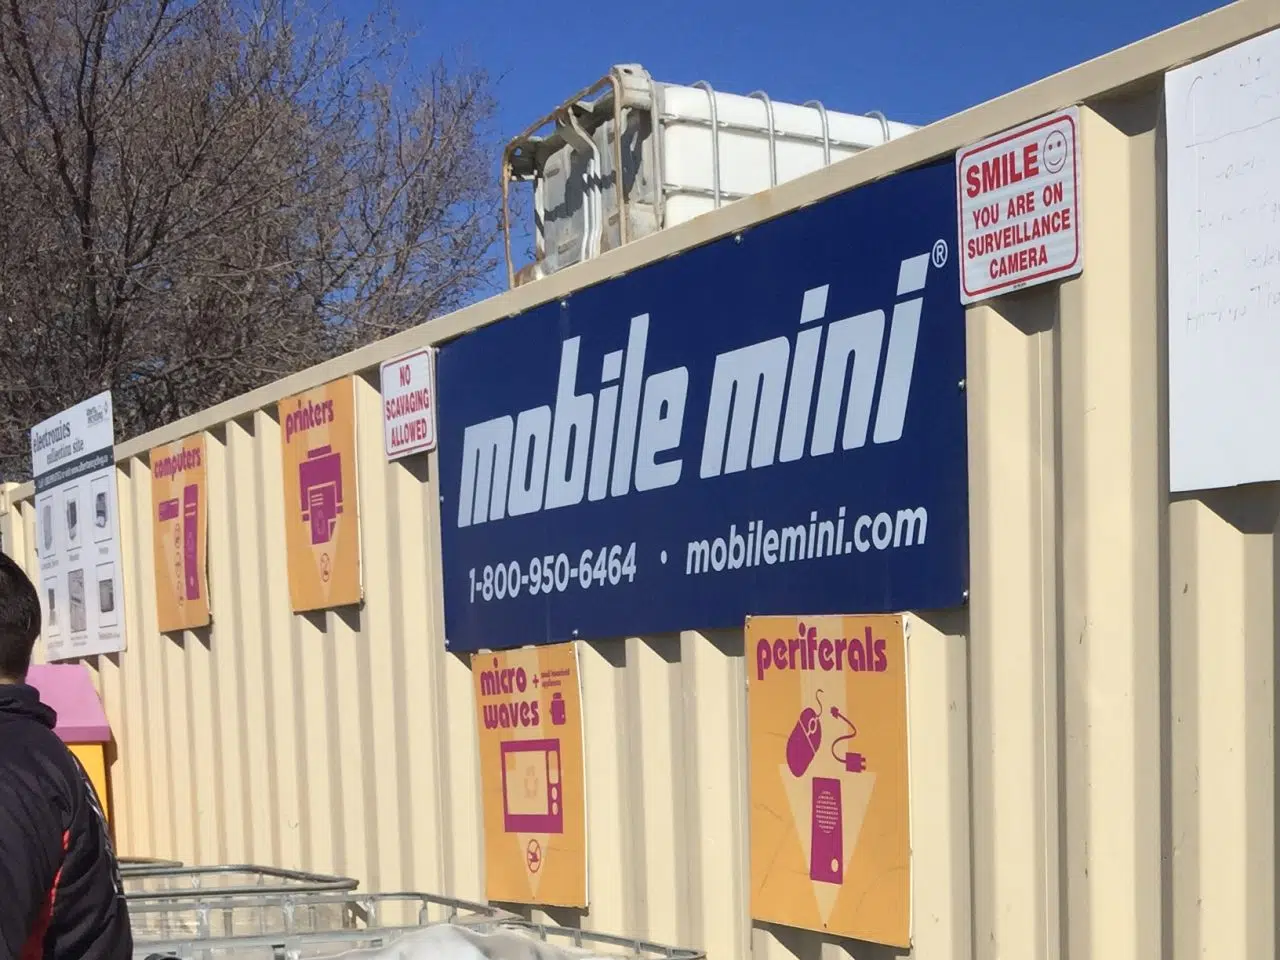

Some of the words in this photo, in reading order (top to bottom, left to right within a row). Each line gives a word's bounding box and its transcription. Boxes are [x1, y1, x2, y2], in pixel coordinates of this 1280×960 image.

[966, 142, 1040, 199] SMILE
[972, 203, 999, 230] YOU
[1007, 191, 1035, 220] ARE
[1042, 182, 1063, 207] ON
[967, 208, 1070, 259] SURVEILLANCE
[989, 245, 1048, 279] CAMERA
[399, 363, 411, 388] NO
[285, 398, 335, 445] printers
[385, 387, 430, 422] SCAVAGING
[457, 312, 690, 529] mobile
[33, 420, 71, 454] electronics
[390, 418, 428, 449] ALLOWED
[153, 444, 202, 482] computers
[468, 541, 637, 605] 1-800-950-6464
[686, 506, 928, 575] mobilemini.com
[755, 621, 888, 681] periferals
[480, 658, 527, 696] micro
[483, 703, 539, 729] waves
